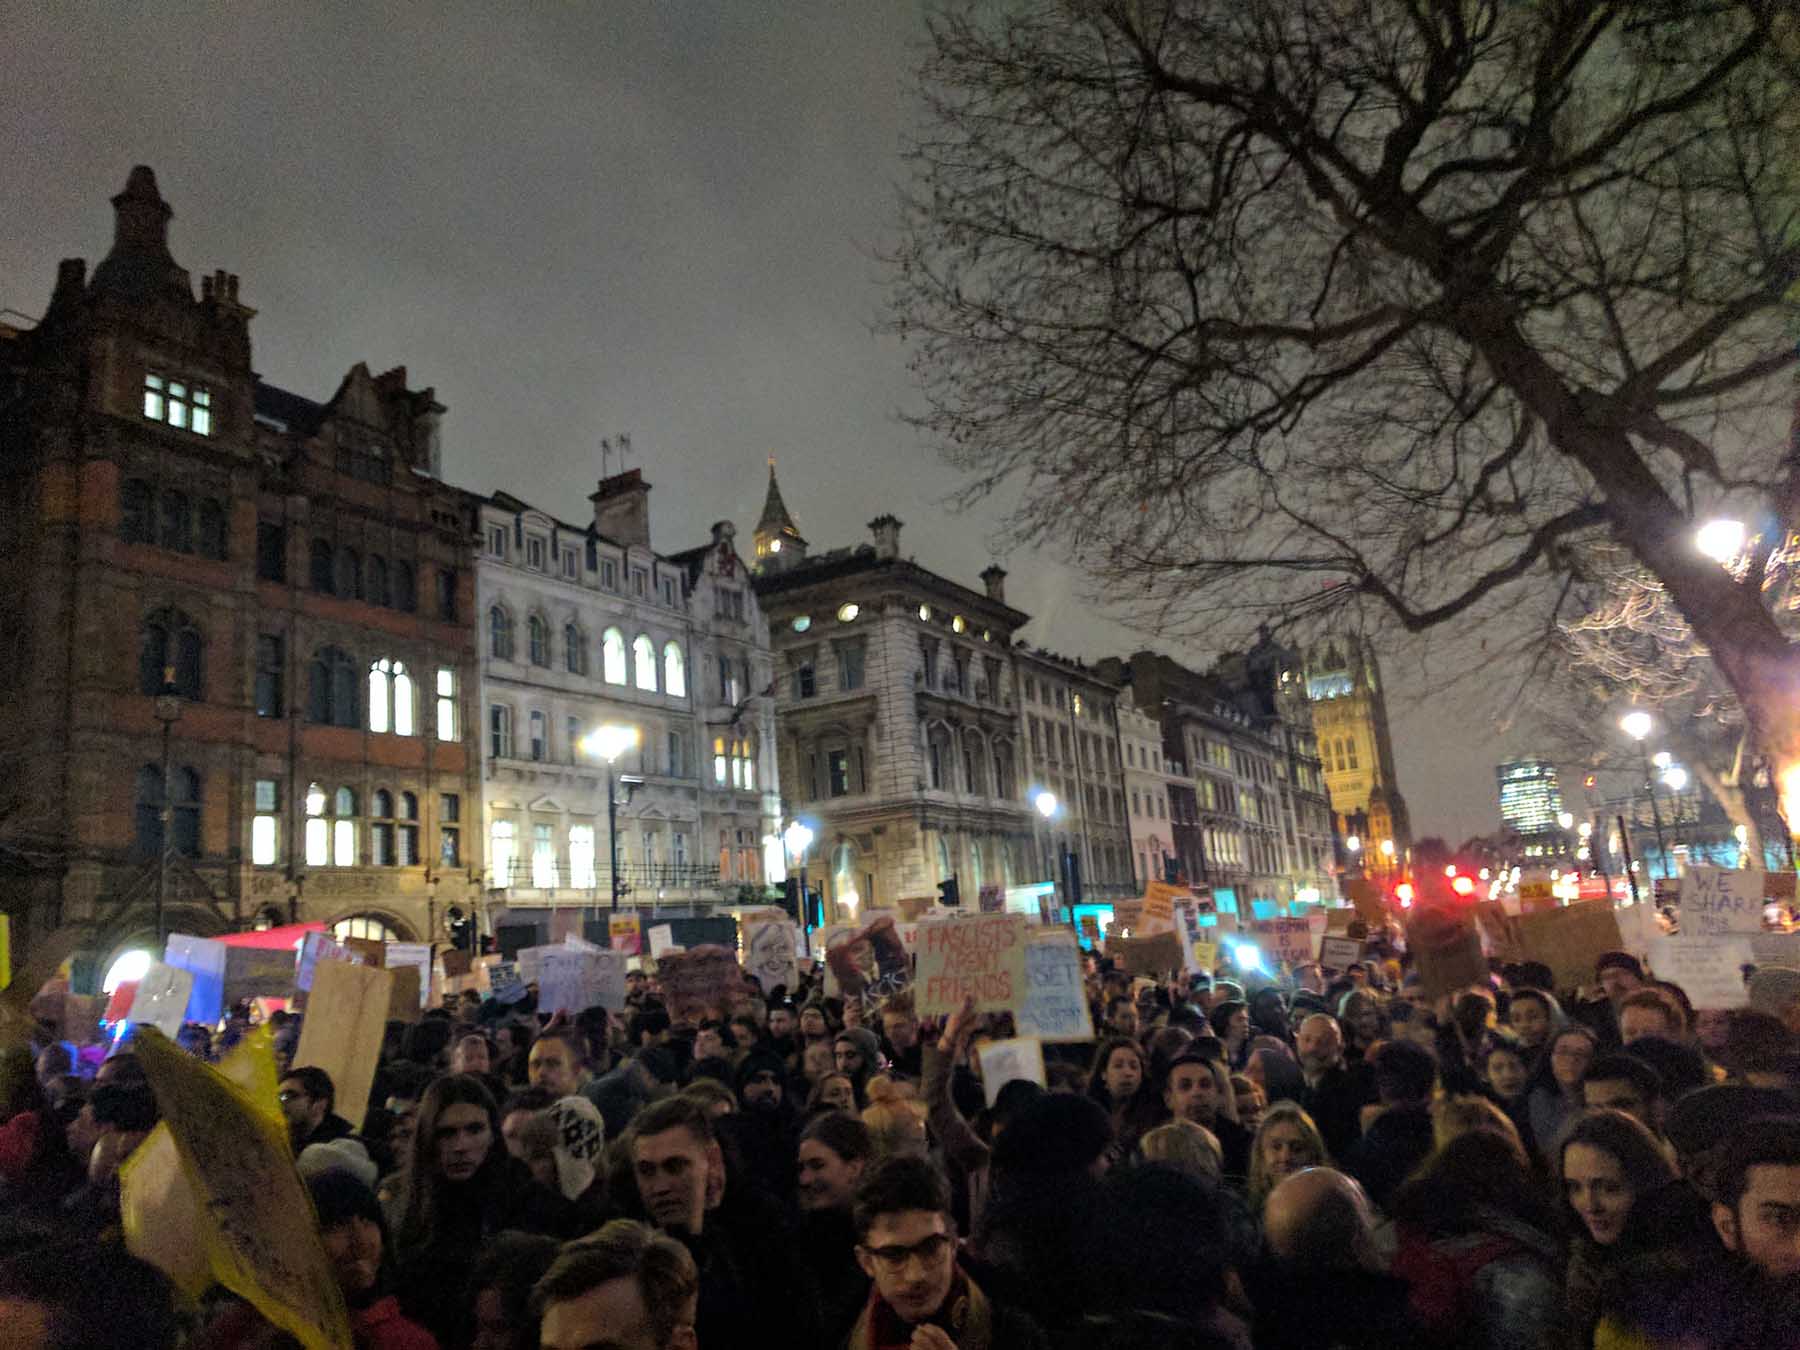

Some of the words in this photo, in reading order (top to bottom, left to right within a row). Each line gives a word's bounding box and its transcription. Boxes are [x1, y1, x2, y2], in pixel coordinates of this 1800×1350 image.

[1694, 871, 1733, 892] WE
[927, 919, 1017, 952] FASCISTS
[927, 970, 1011, 1003] FRIENDS
